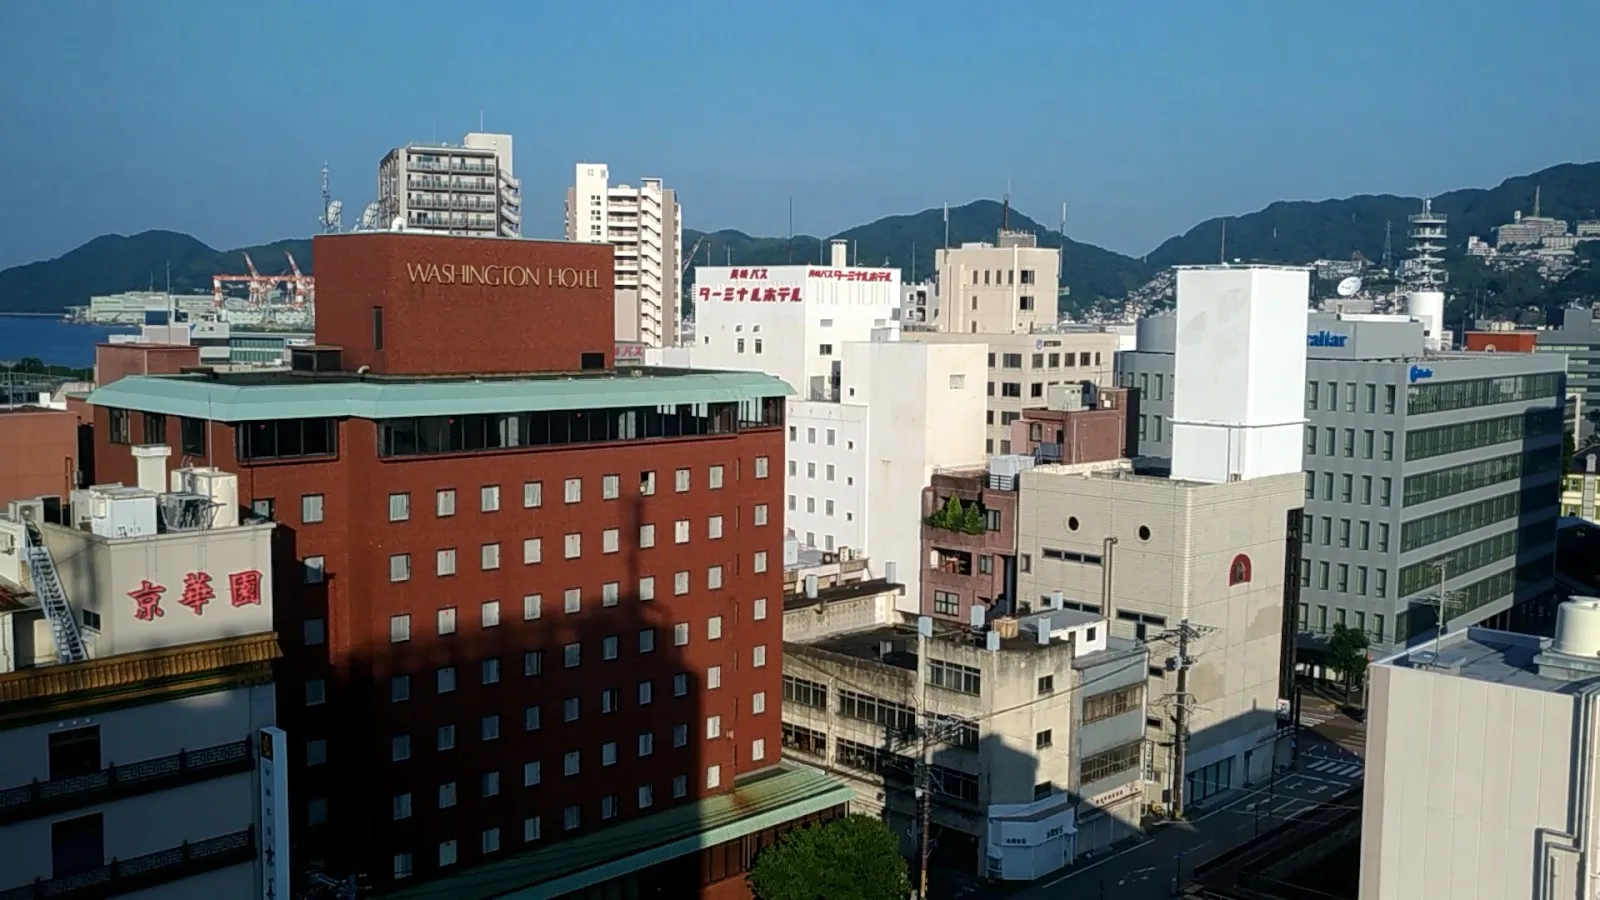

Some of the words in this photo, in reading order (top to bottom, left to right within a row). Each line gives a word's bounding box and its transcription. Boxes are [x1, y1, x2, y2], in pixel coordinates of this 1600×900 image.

[406, 263, 540, 286] WASHINGTON
[549, 268, 601, 288] HOTEL
[699, 287, 803, 303] ターミナルホテル
[127, 570, 263, 621] 京華園
